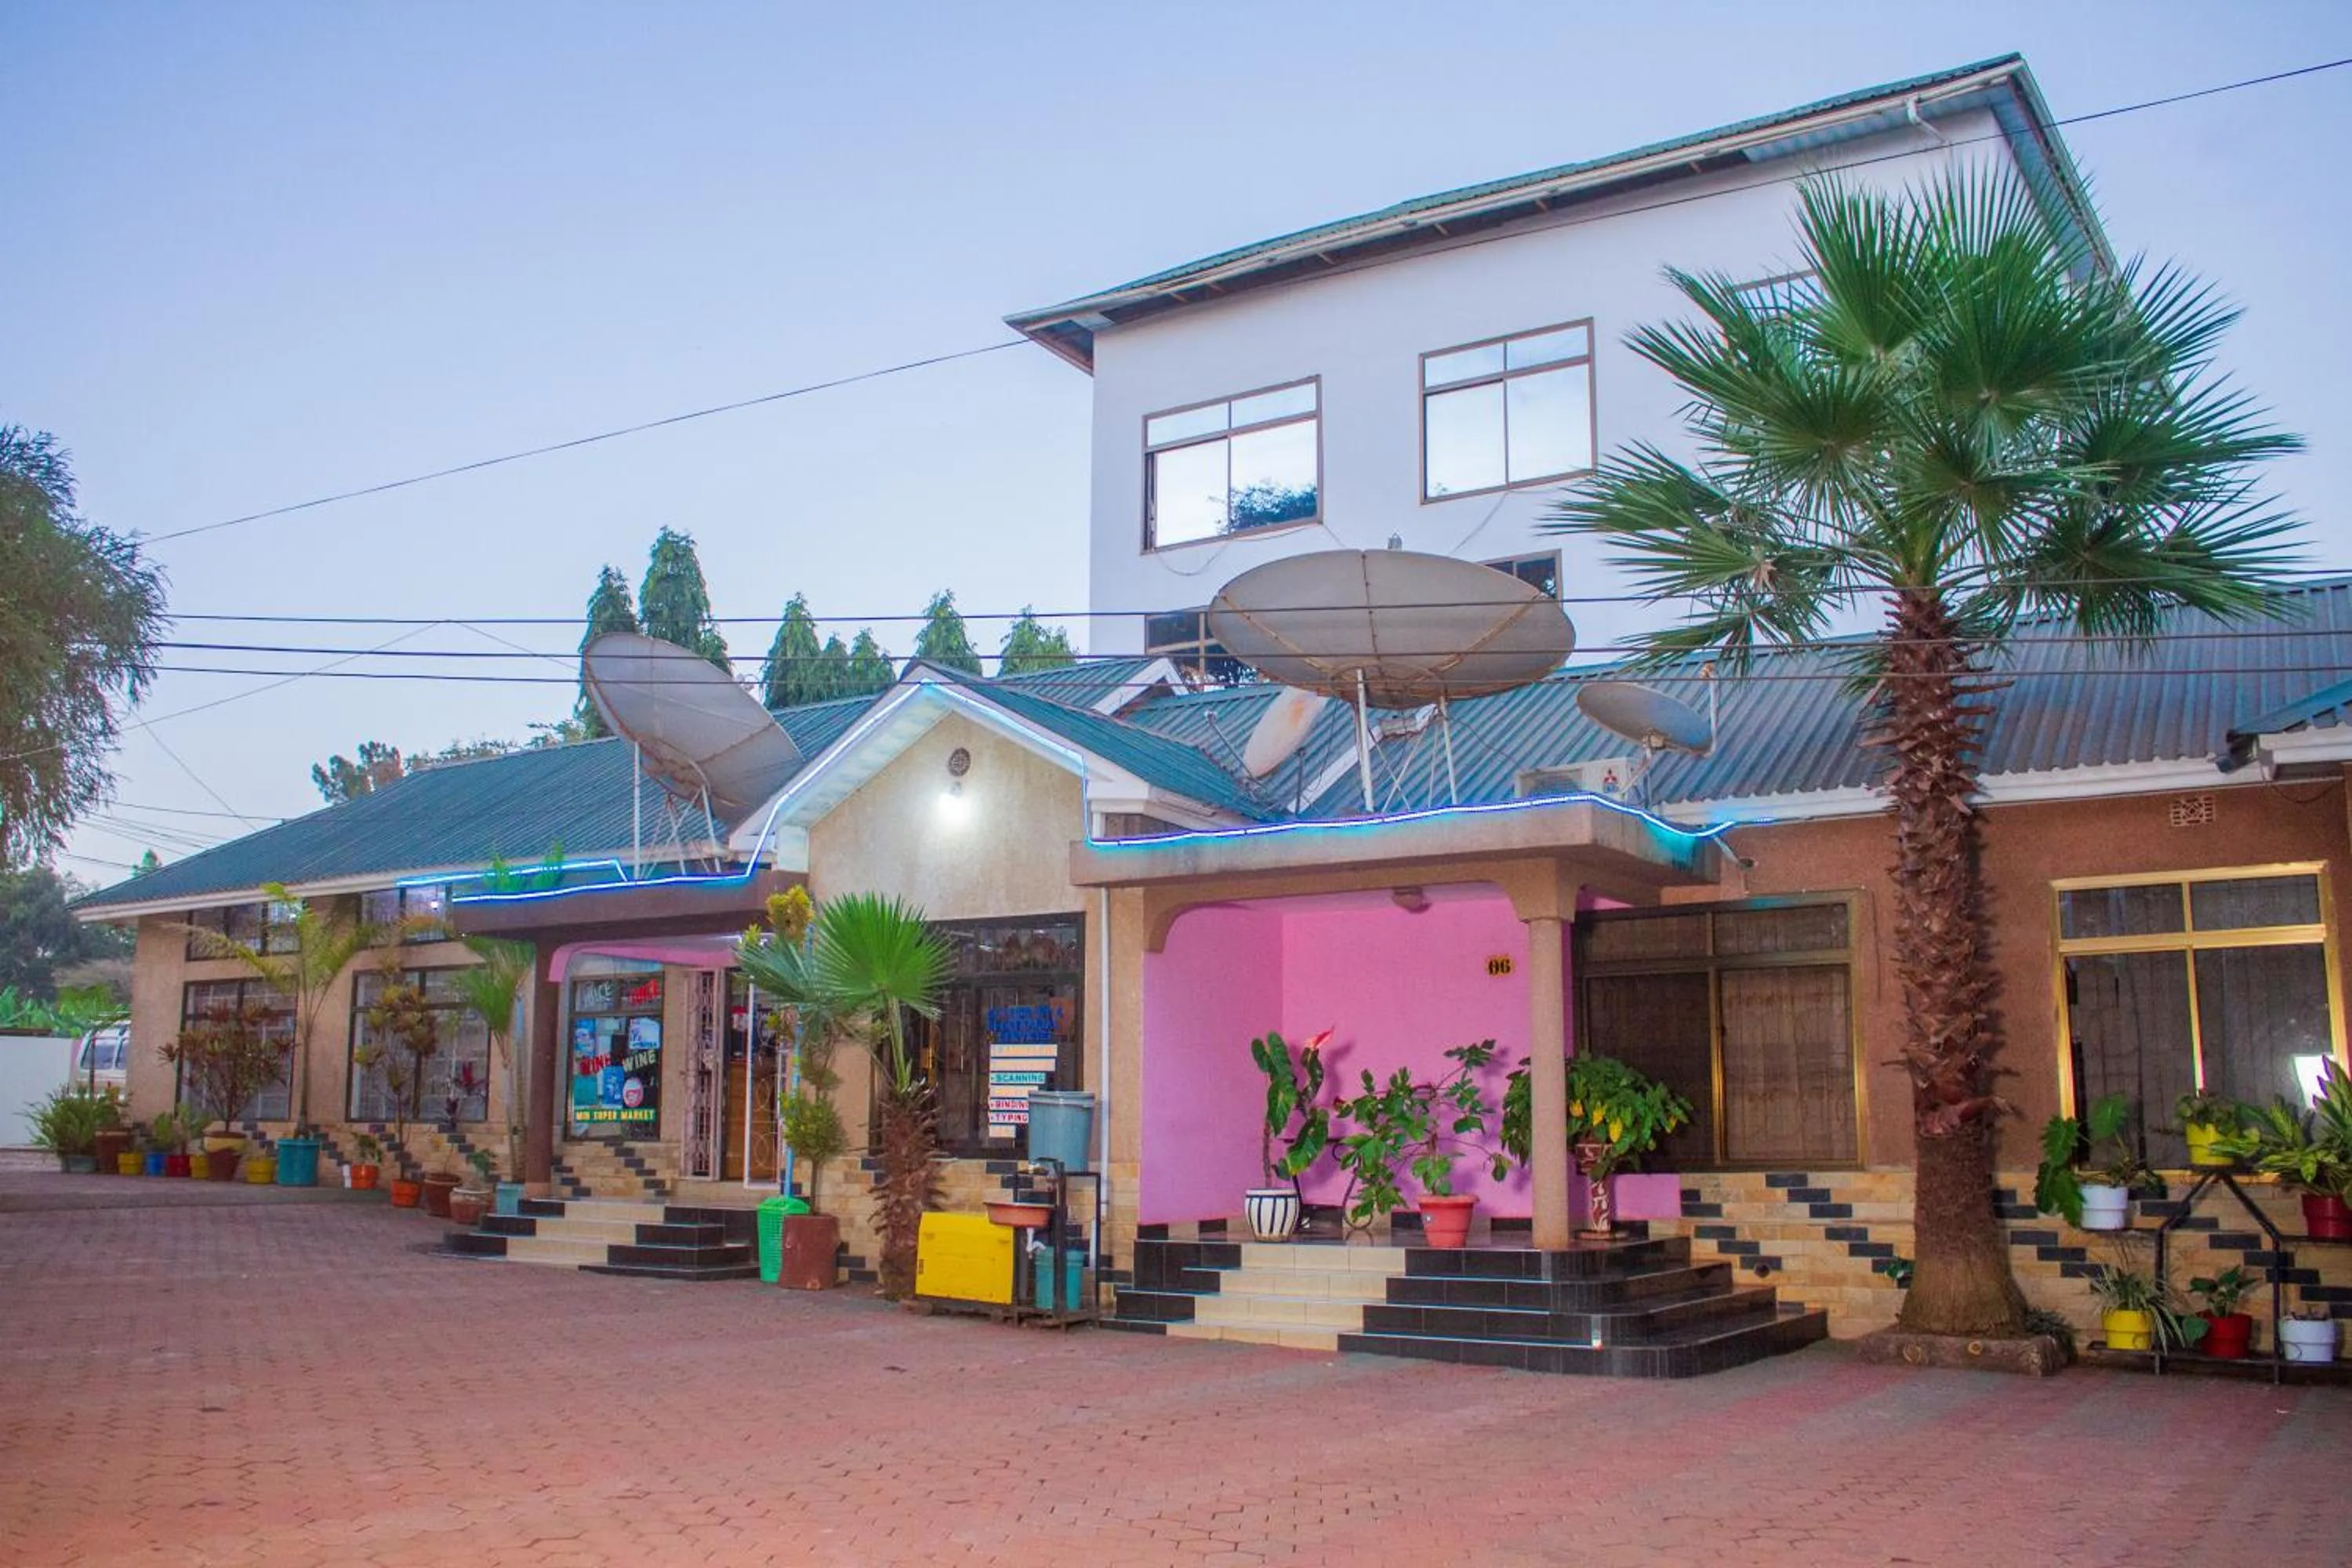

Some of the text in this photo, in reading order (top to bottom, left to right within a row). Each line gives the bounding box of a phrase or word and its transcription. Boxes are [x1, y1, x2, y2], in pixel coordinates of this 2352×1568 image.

[622, 1050, 656, 1073] WINE
[996, 1073, 1044, 1082] SCANNING
[621, 1109, 653, 1120] MARKET
[996, 1113, 1028, 1122] TYPING
